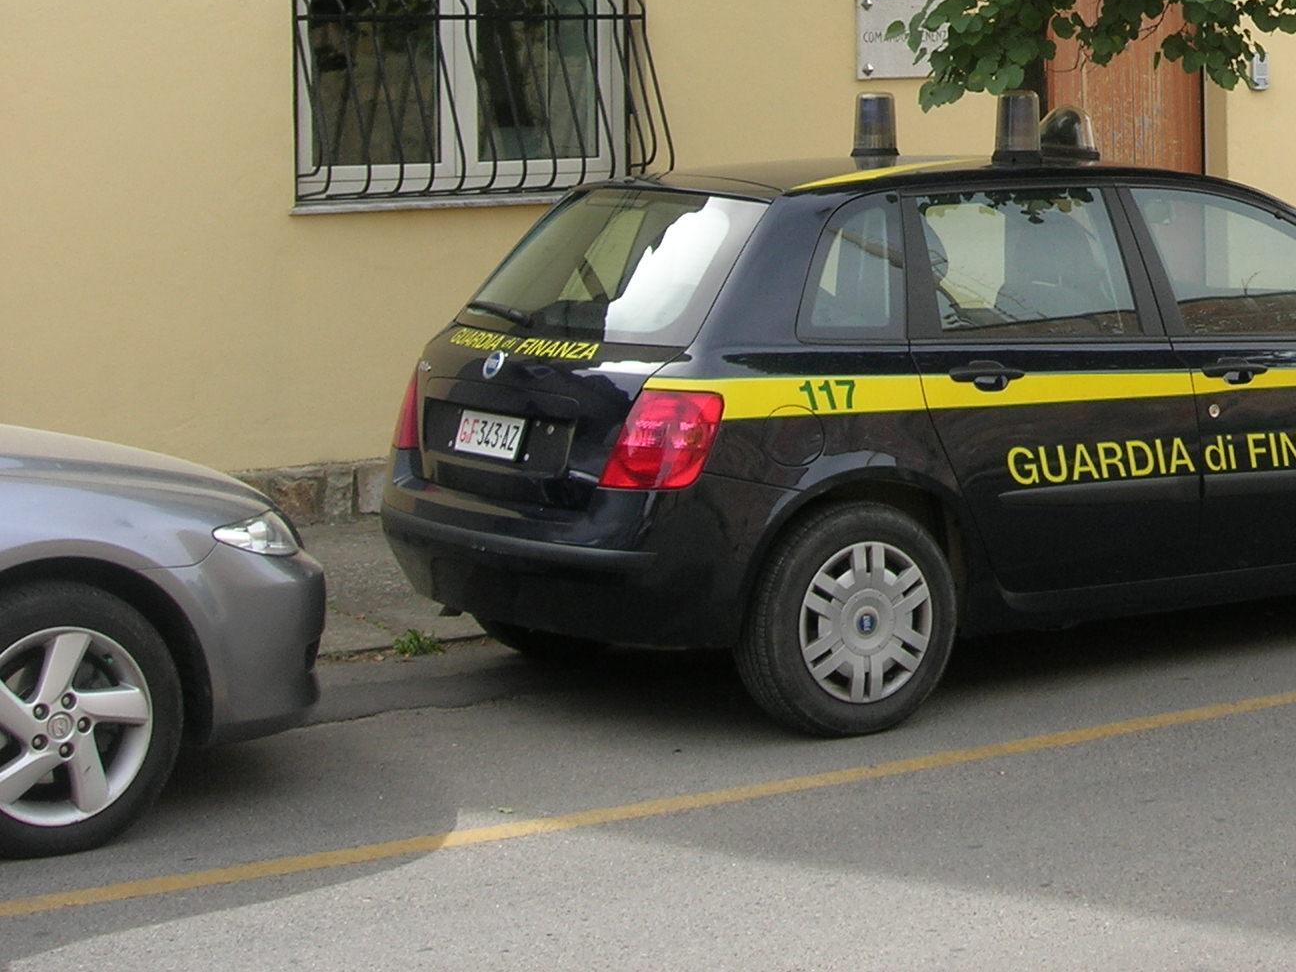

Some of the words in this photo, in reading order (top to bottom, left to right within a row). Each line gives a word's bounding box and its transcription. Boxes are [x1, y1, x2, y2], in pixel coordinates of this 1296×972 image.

[450, 327, 503, 351] GUARDIA
[513, 337, 600, 360] FINANZA
[798, 379, 856, 410] 117
[1006, 436, 1196, 486] GUARDIA
[1204, 434, 1238, 472] di
